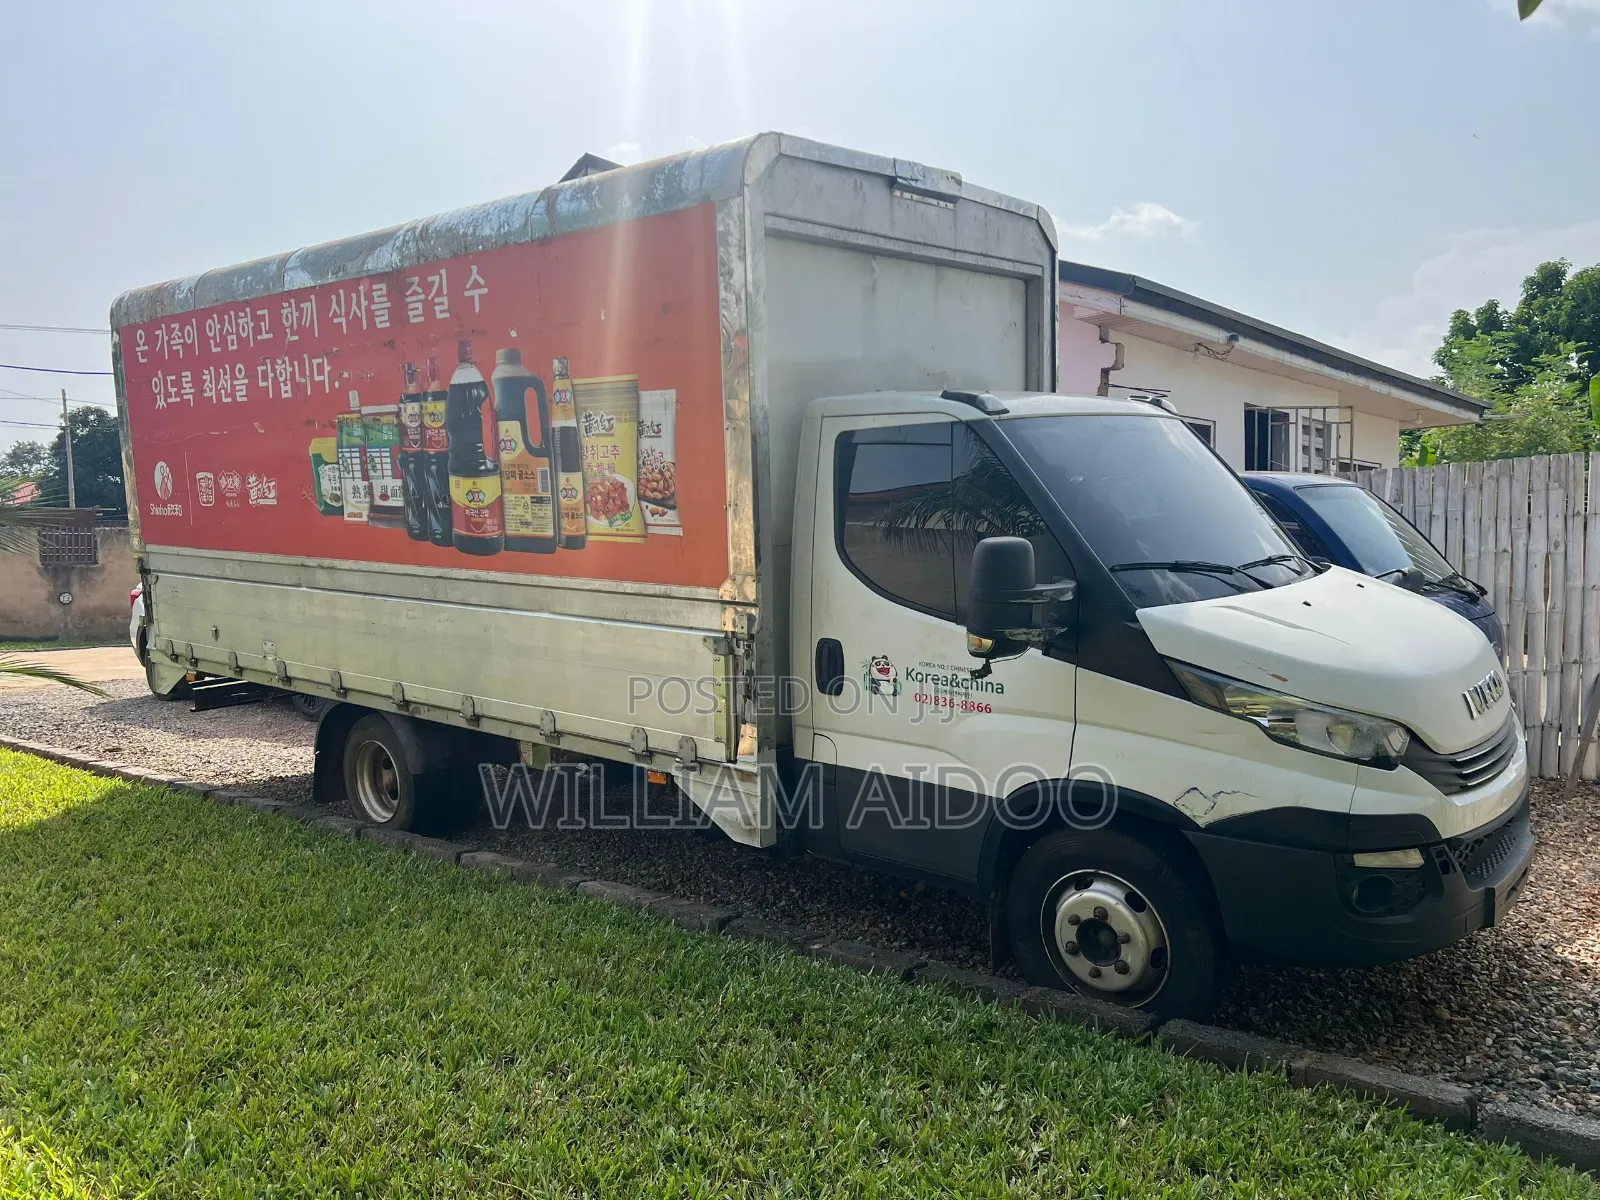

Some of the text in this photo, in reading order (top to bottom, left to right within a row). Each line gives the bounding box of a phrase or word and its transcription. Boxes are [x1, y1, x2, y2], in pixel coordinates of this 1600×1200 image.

[135, 264, 489, 363] 온 가족이 안심하고 한끼 식사를 즐길 수
[151, 353, 340, 410] 있도록 최선을 다합니다.
[918, 661, 937, 669] KOREA
[905, 667, 1005, 695] Korea&china
[914, 692, 992, 714] 02)836-8866
